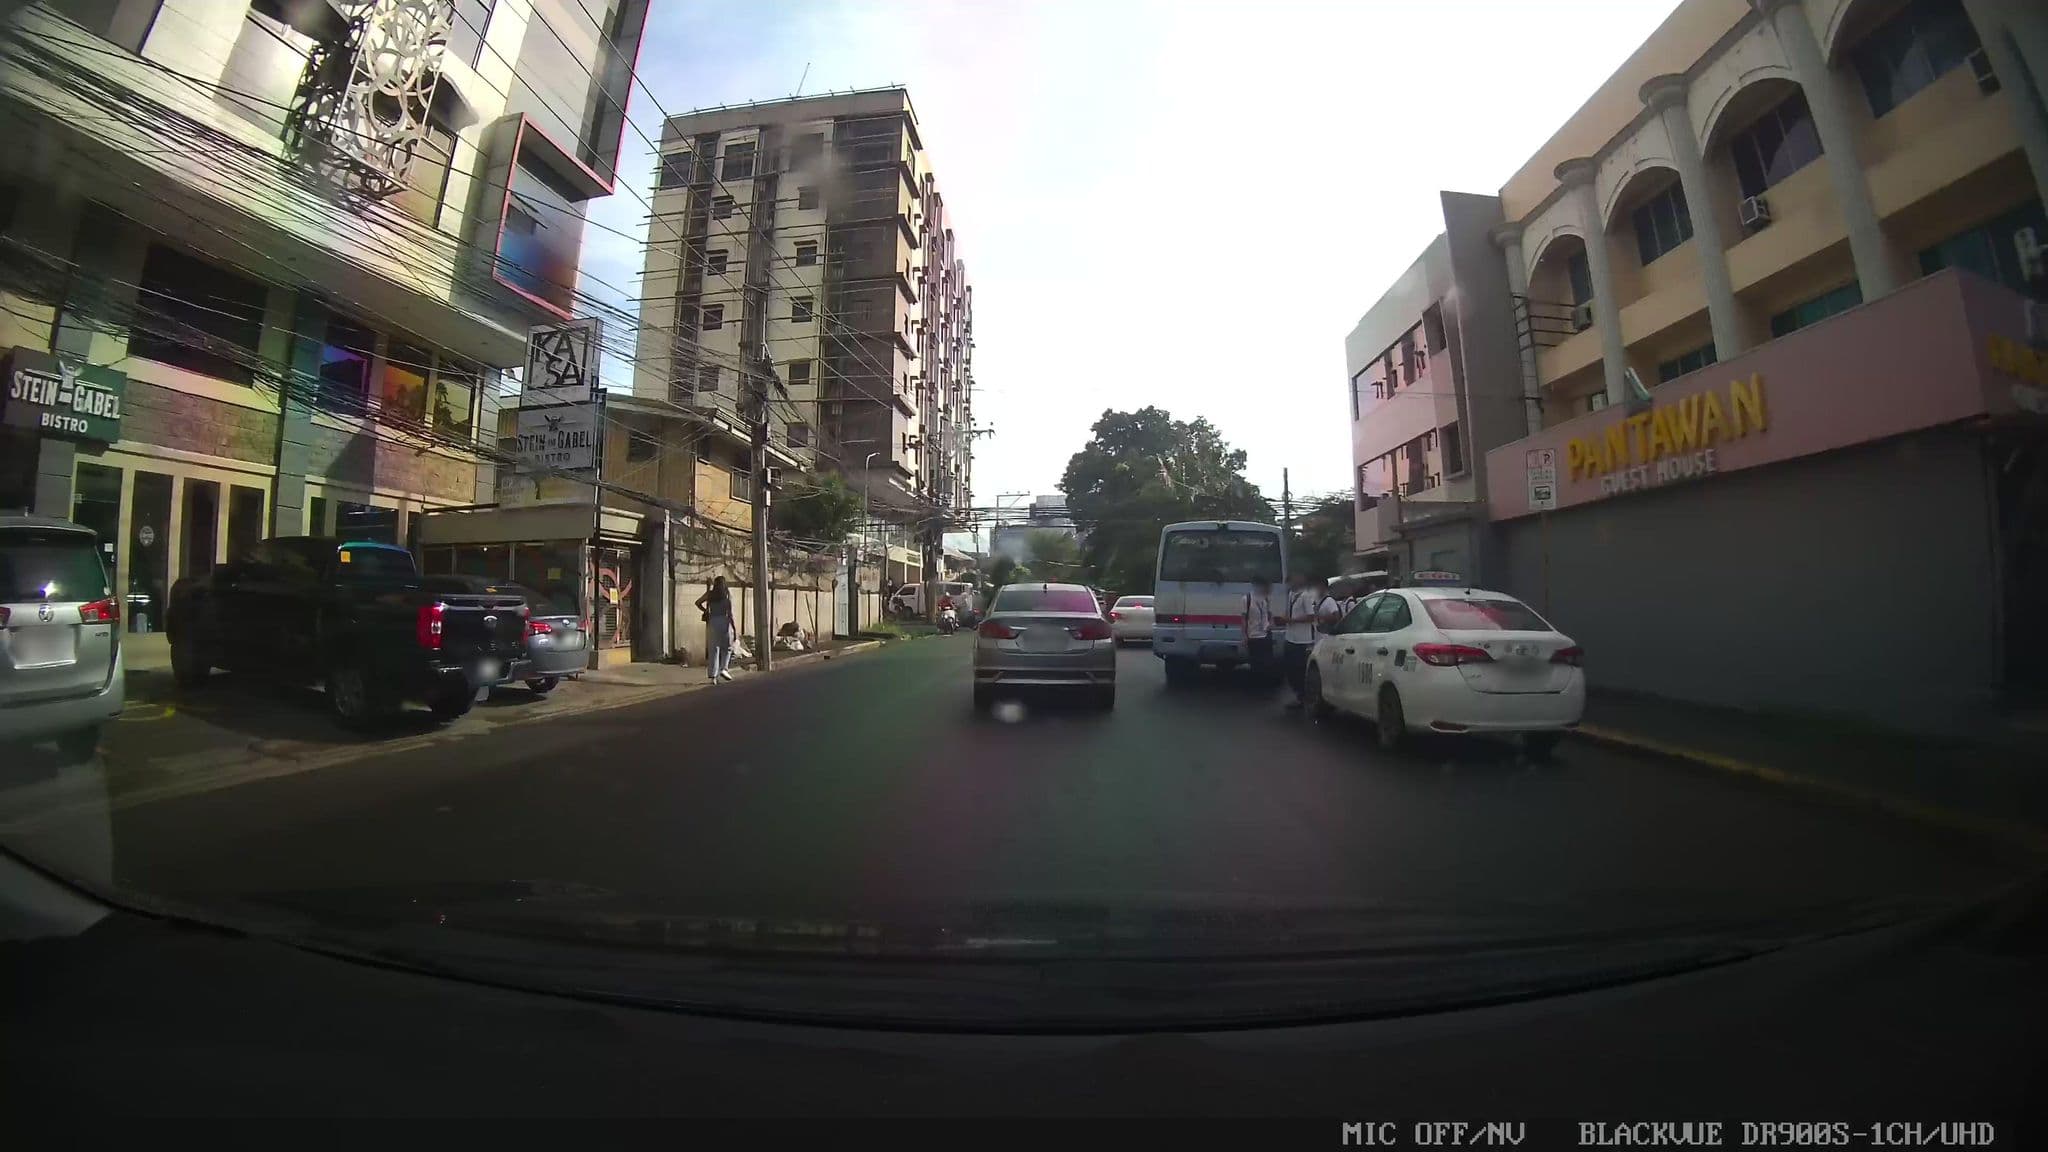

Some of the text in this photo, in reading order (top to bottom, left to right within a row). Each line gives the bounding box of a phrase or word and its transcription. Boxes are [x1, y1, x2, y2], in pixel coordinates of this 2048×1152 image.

[11, 371, 120, 419] STEIN GABEL
[41, 413, 88, 433] BISTRO
[517, 433, 546, 451] STEIN
[557, 430, 592, 449] GABEL
[1568, 371, 1768, 482] PANTAWAN
[1657, 448, 1717, 486] HOUSE
